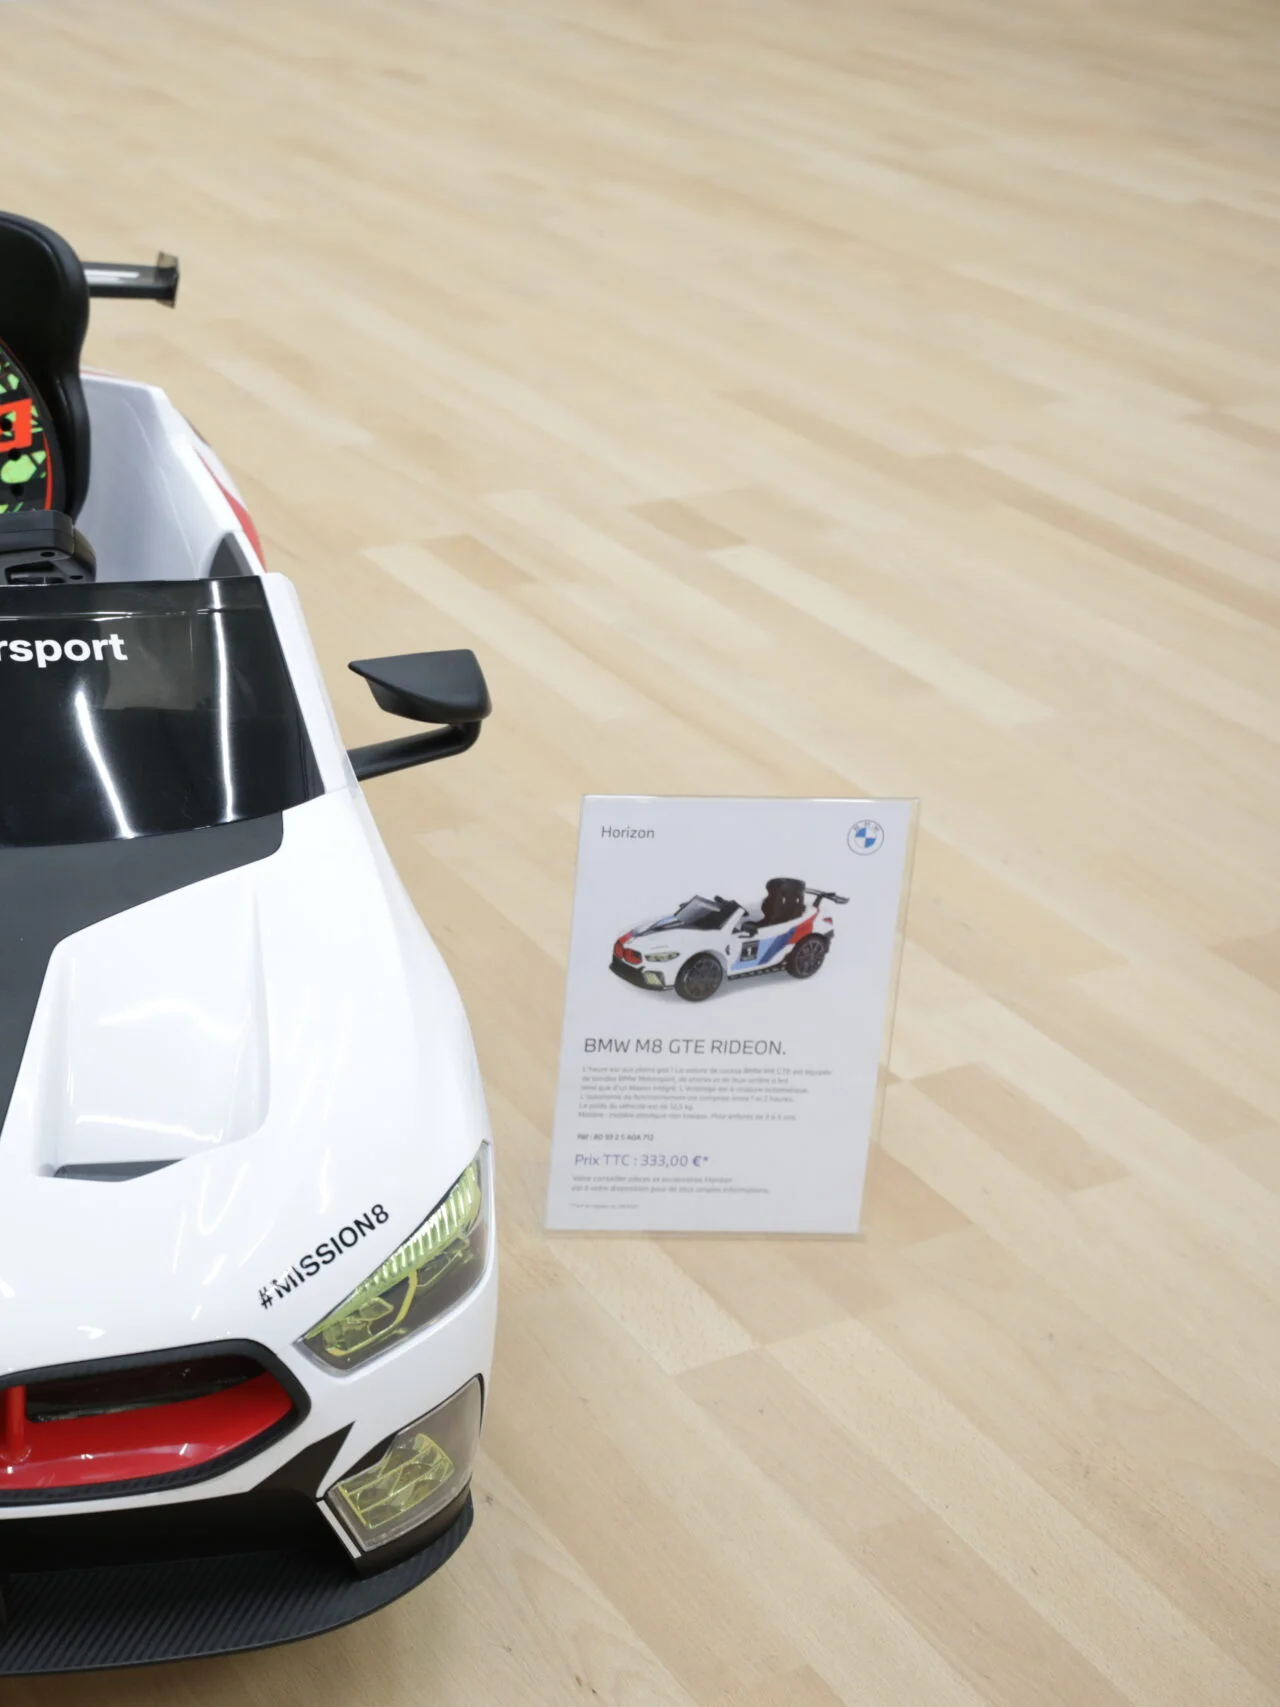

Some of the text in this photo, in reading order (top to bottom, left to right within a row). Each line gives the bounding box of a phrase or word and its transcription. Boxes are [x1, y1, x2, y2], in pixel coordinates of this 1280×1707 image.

[601, 824, 655, 839] Horizon
[584, 1038, 787, 1055] BMW M8 GTE RIDEON.
[574, 1153, 600, 1166] Prix
[603, 1154, 631, 1167] TTC
[640, 1154, 688, 1168] 333,00
[258, 1203, 390, 1310] #MISSION8
